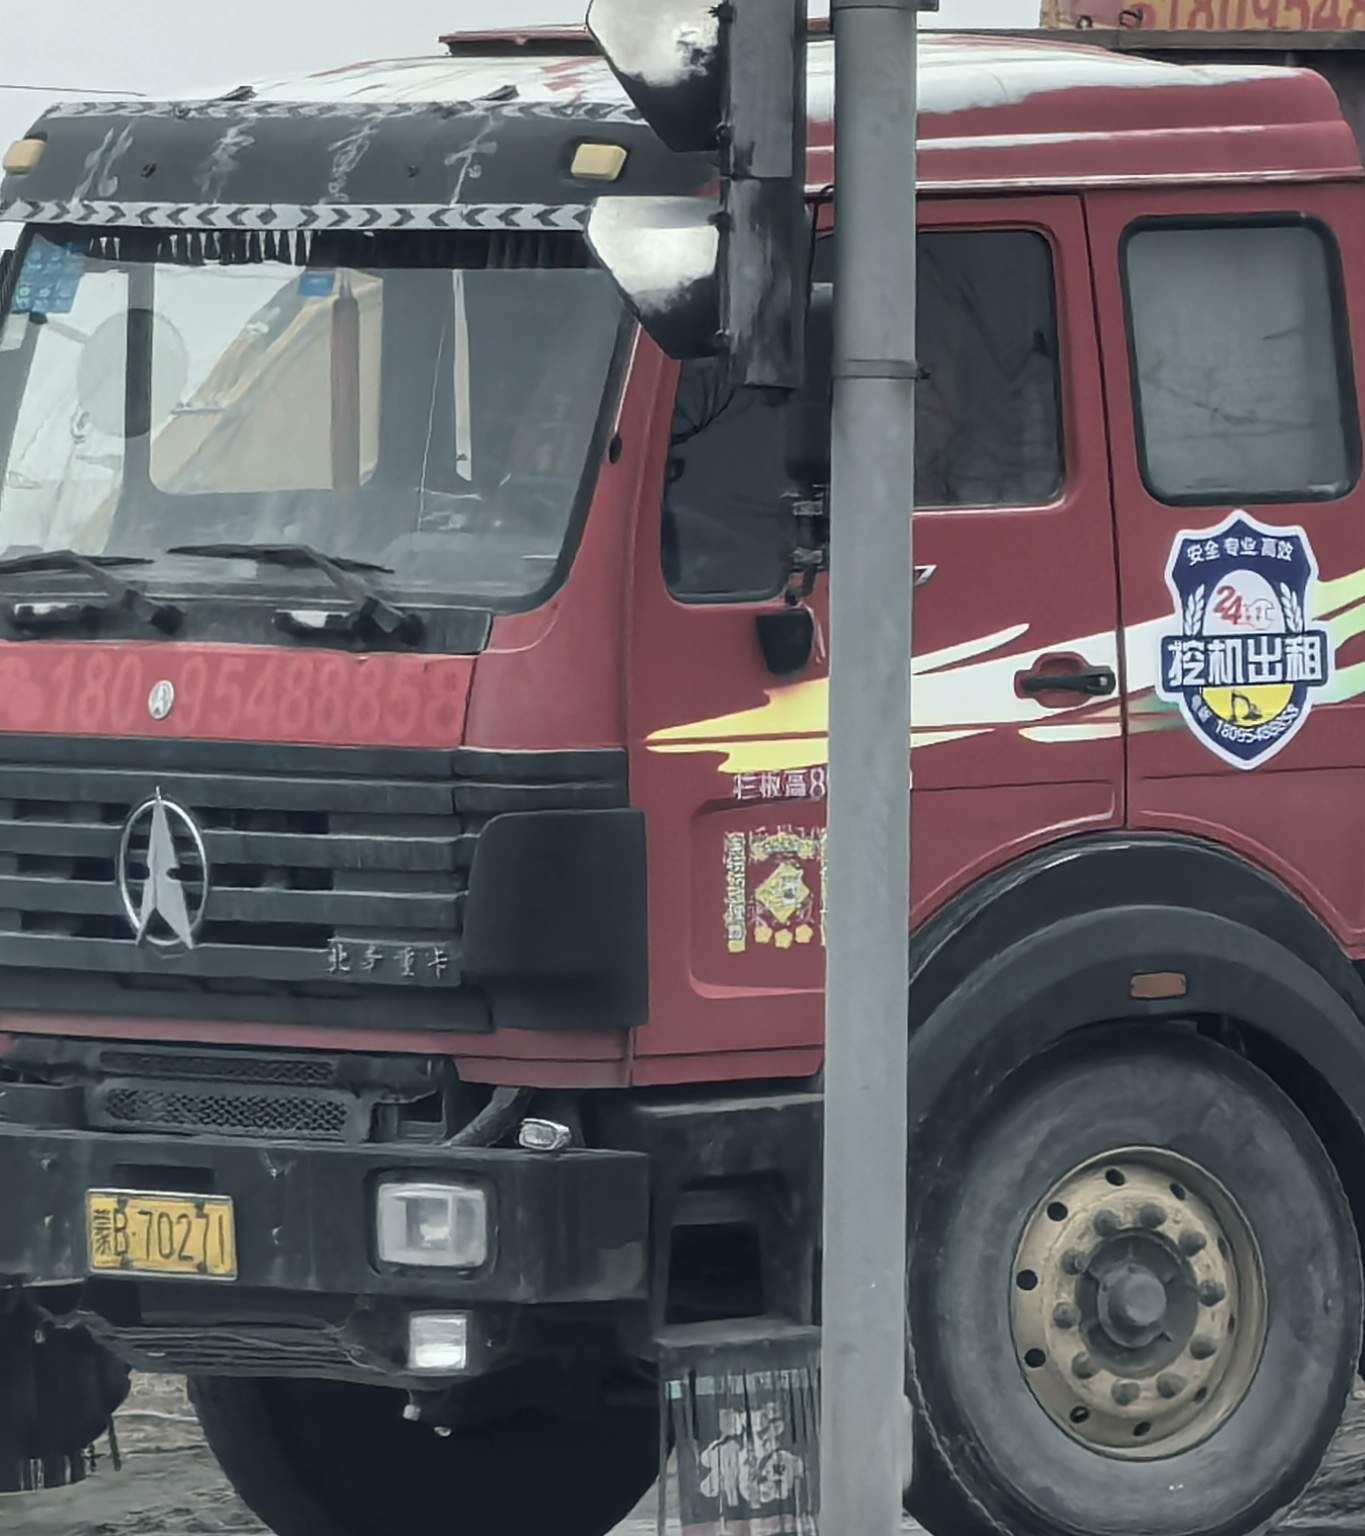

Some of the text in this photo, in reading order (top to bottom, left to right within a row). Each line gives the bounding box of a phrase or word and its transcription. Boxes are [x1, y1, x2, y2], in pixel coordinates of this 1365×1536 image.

[1186, 540, 1221, 566] 安全
[1168, 636, 1322, 687] 挖机出租
